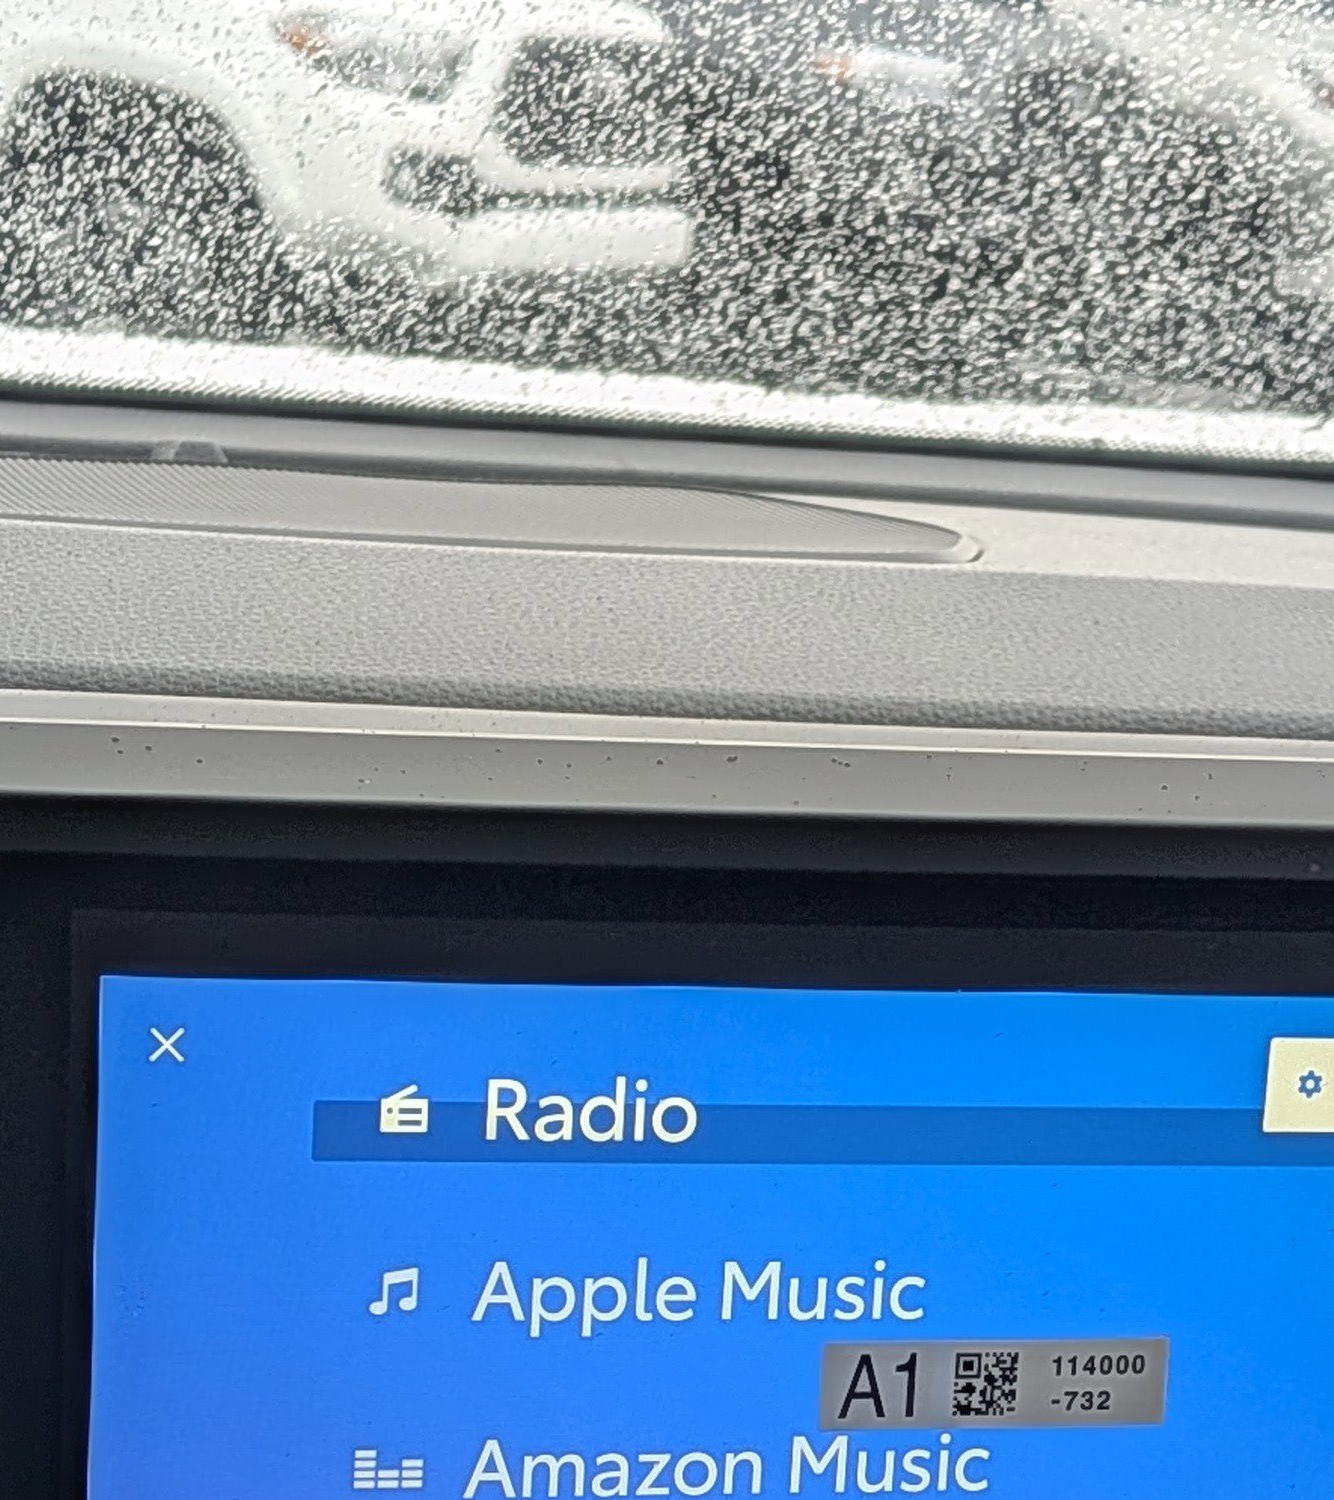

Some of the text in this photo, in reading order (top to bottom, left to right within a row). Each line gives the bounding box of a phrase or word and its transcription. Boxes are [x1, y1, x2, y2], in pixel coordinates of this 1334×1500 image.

[482, 1076, 700, 1145] Radio
[471, 1259, 927, 1339] Apple Music
[837, 1351, 919, 1420] A1
[1052, 1354, 1146, 1377] 114000
[1050, 1390, 1112, 1412] -732
[461, 1433, 991, 1500] Amazon Music
